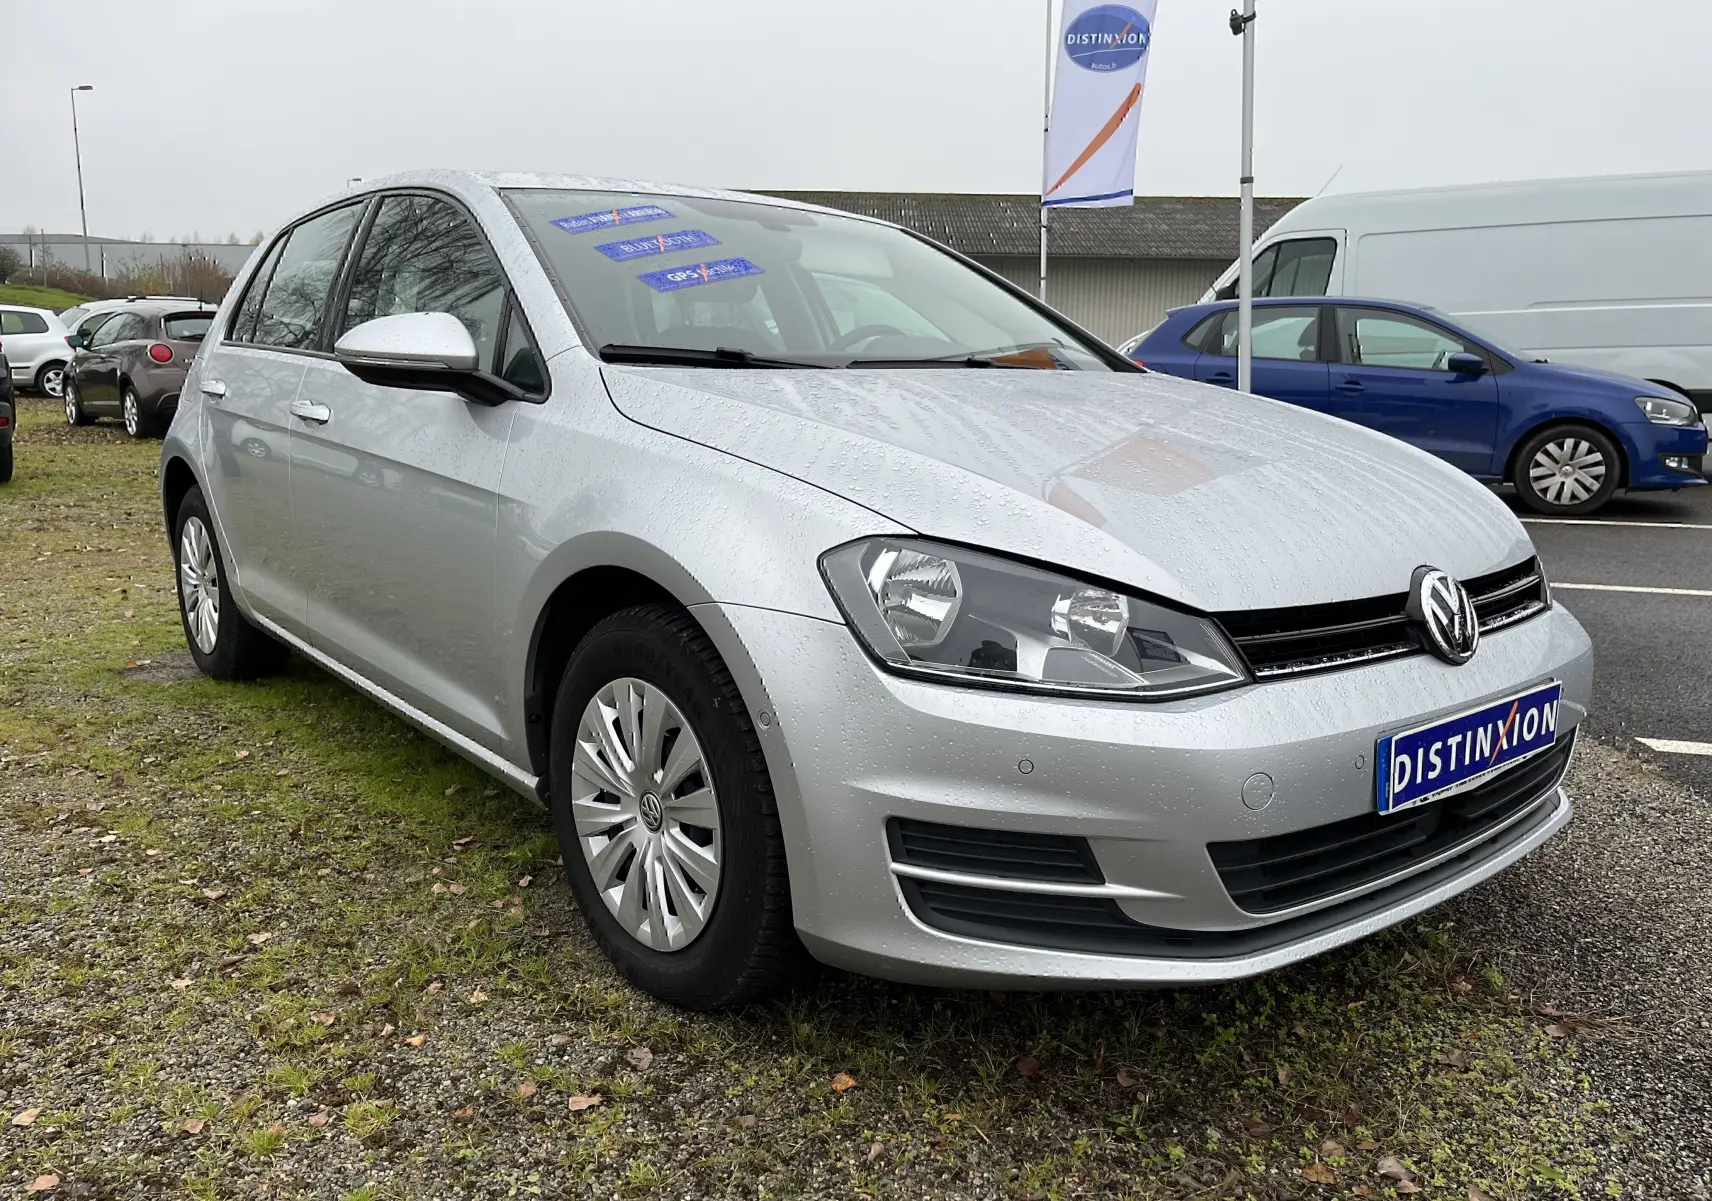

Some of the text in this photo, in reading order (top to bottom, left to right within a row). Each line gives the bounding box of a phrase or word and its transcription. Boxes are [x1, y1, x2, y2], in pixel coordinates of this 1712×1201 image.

[1066, 29, 1148, 47] DISTINXION
[620, 235, 697, 253] BLUETOOTH
[667, 269, 698, 281] GPS
[1394, 700, 1557, 794] DISTINXION
